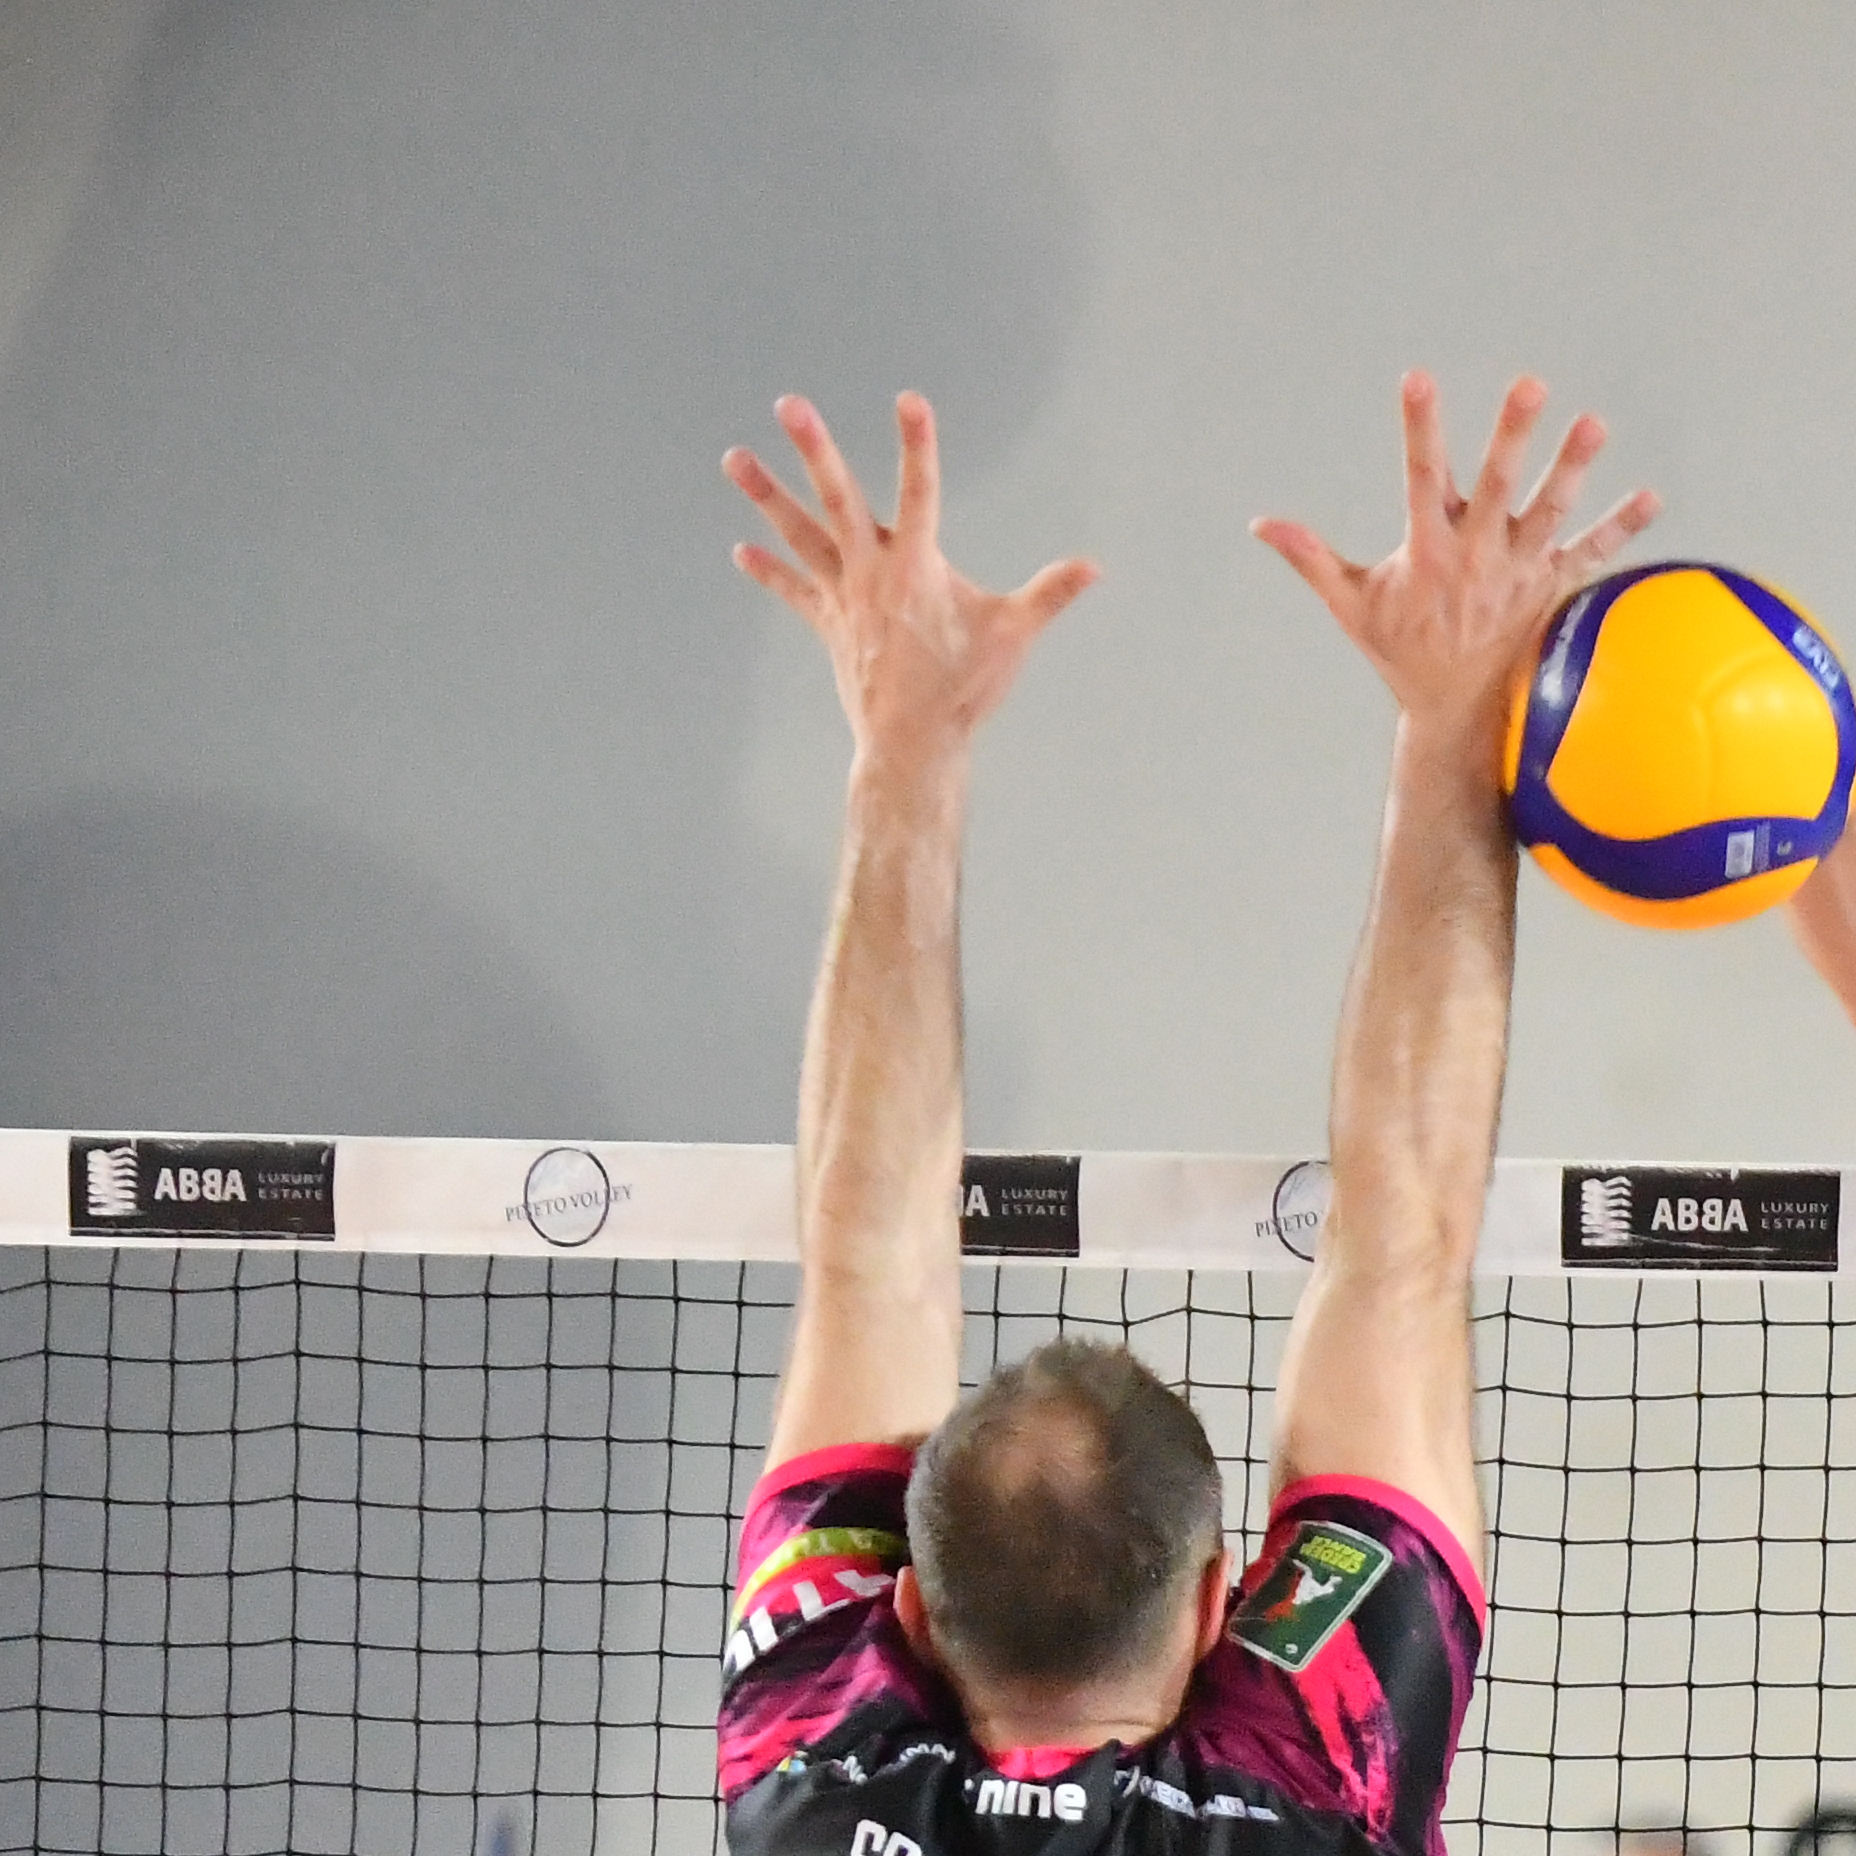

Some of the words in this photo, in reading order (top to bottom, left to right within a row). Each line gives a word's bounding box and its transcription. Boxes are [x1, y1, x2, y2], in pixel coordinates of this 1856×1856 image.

[154, 1168, 247, 1201] ABBA
[257, 1171, 325, 1185] LUXURY
[257, 1187, 325, 1201] ESTATE
[1002, 1187, 1068, 1201] LUXURY
[1002, 1203, 1068, 1216] ESTATE
[1760, 1201, 1830, 1215] LUXURY
[1651, 1198, 1749, 1233] ABBA
[1760, 1217, 1830, 1231] ESTATE
[976, 1778, 1088, 1822] nine
